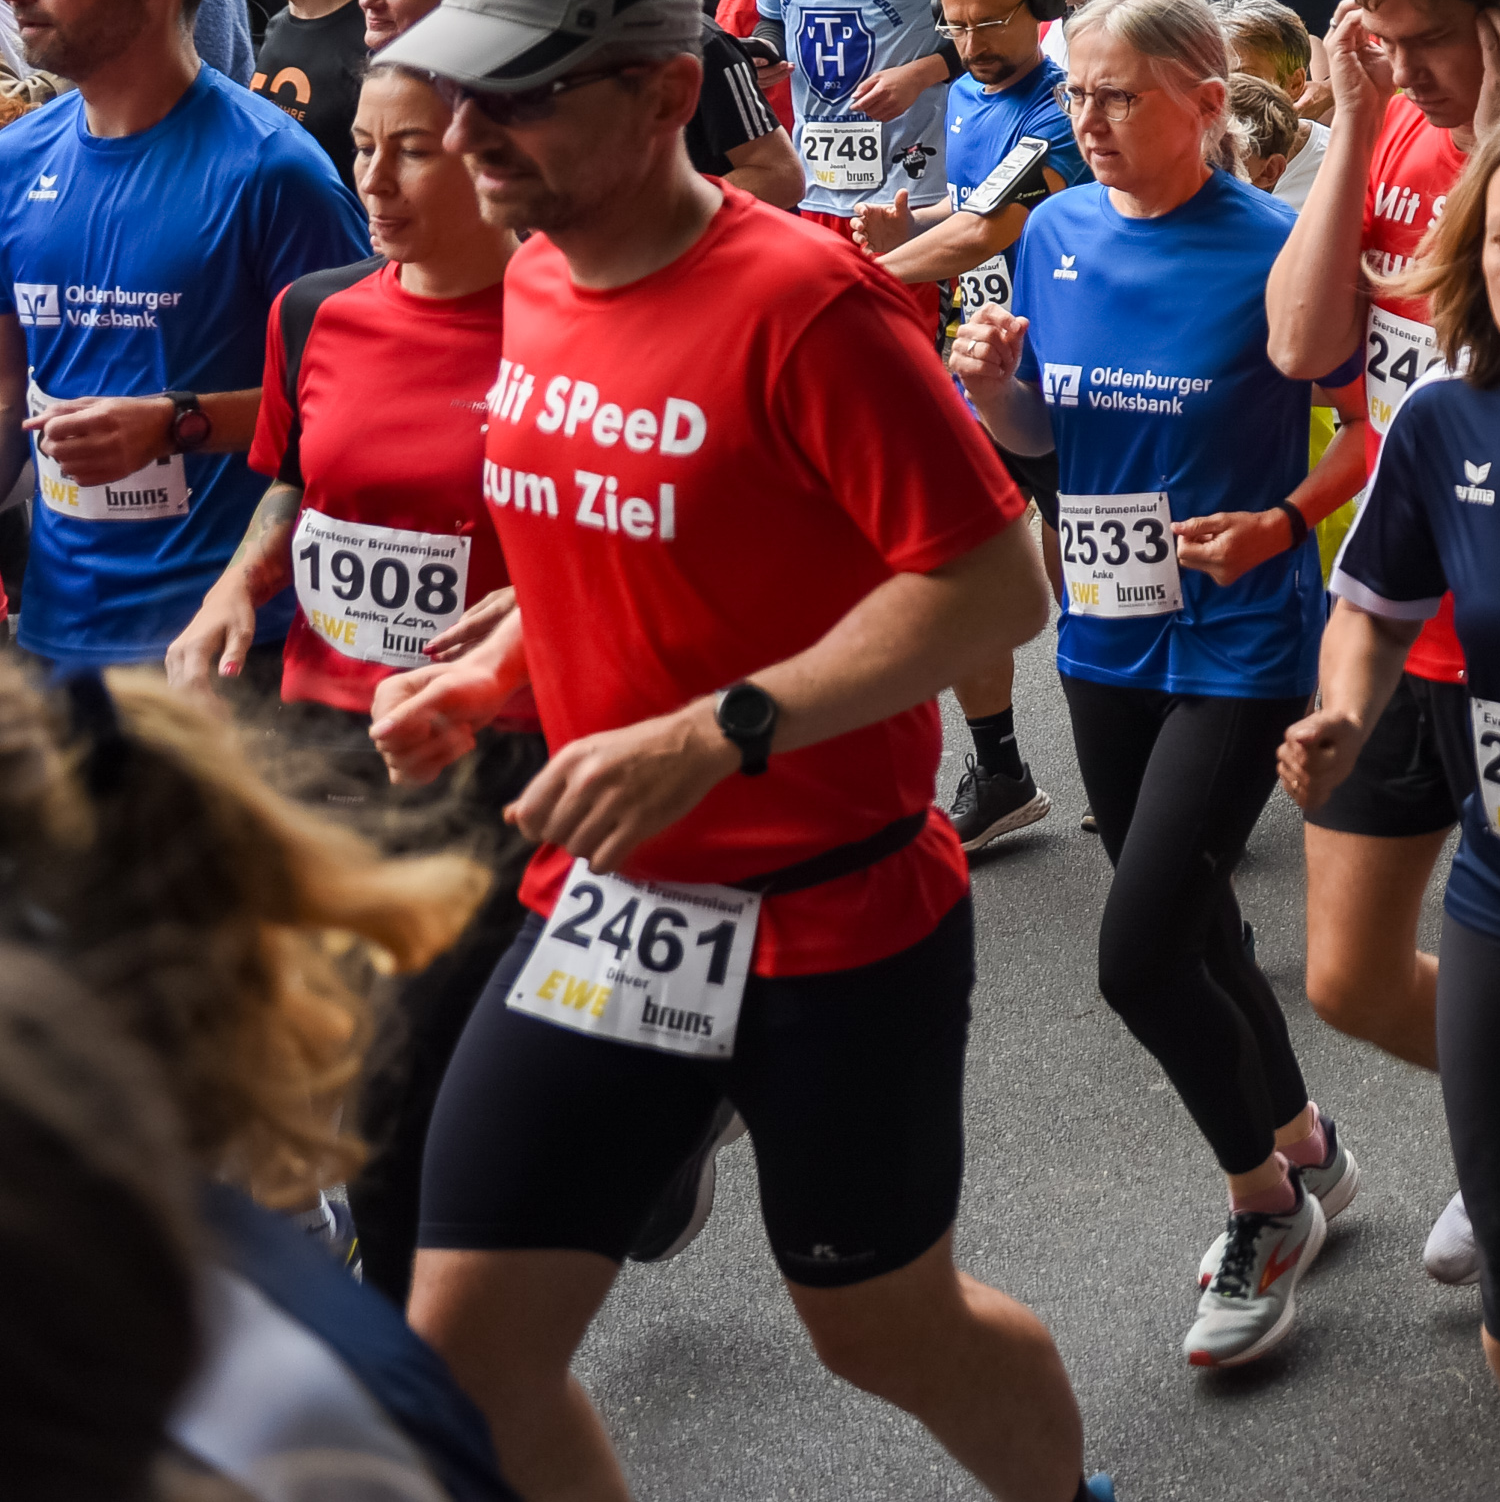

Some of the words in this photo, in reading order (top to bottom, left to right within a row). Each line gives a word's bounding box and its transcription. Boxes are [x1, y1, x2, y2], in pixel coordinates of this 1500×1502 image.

[823, 81, 842, 90] 1902
[804, 135, 878, 161] 2748
[846, 170, 874, 182] bruns
[1374, 182, 1420, 225] Mit
[65, 284, 182, 310] Oldenburger
[1373, 315, 1422, 344] Everstener
[1368, 330, 1445, 392] 24
[1090, 366, 1213, 396] Oldenburger
[536, 374, 707, 458] SPeeD
[1088, 391, 1183, 415] Volksbank
[43, 475, 79, 506] EWE
[105, 485, 168, 506] bruns
[574, 469, 675, 542] Ziel
[1454, 483, 1495, 505] erima
[1095, 502, 1158, 514] Brunnenlauf
[305, 523, 366, 547] Everstener
[368, 538, 456, 559] Brunnenlauf
[1061, 518, 1169, 565] 2533
[299, 541, 458, 615] 1908
[1092, 570, 1114, 579] Anke
[1071, 582, 1099, 605] EWE
[1116, 582, 1166, 602] bruns
[311, 609, 358, 646] EWE
[383, 627, 431, 654] brun
[551, 879, 737, 986] 2461
[536, 969, 613, 1018] EWE
[641, 996, 715, 1036] bruns
